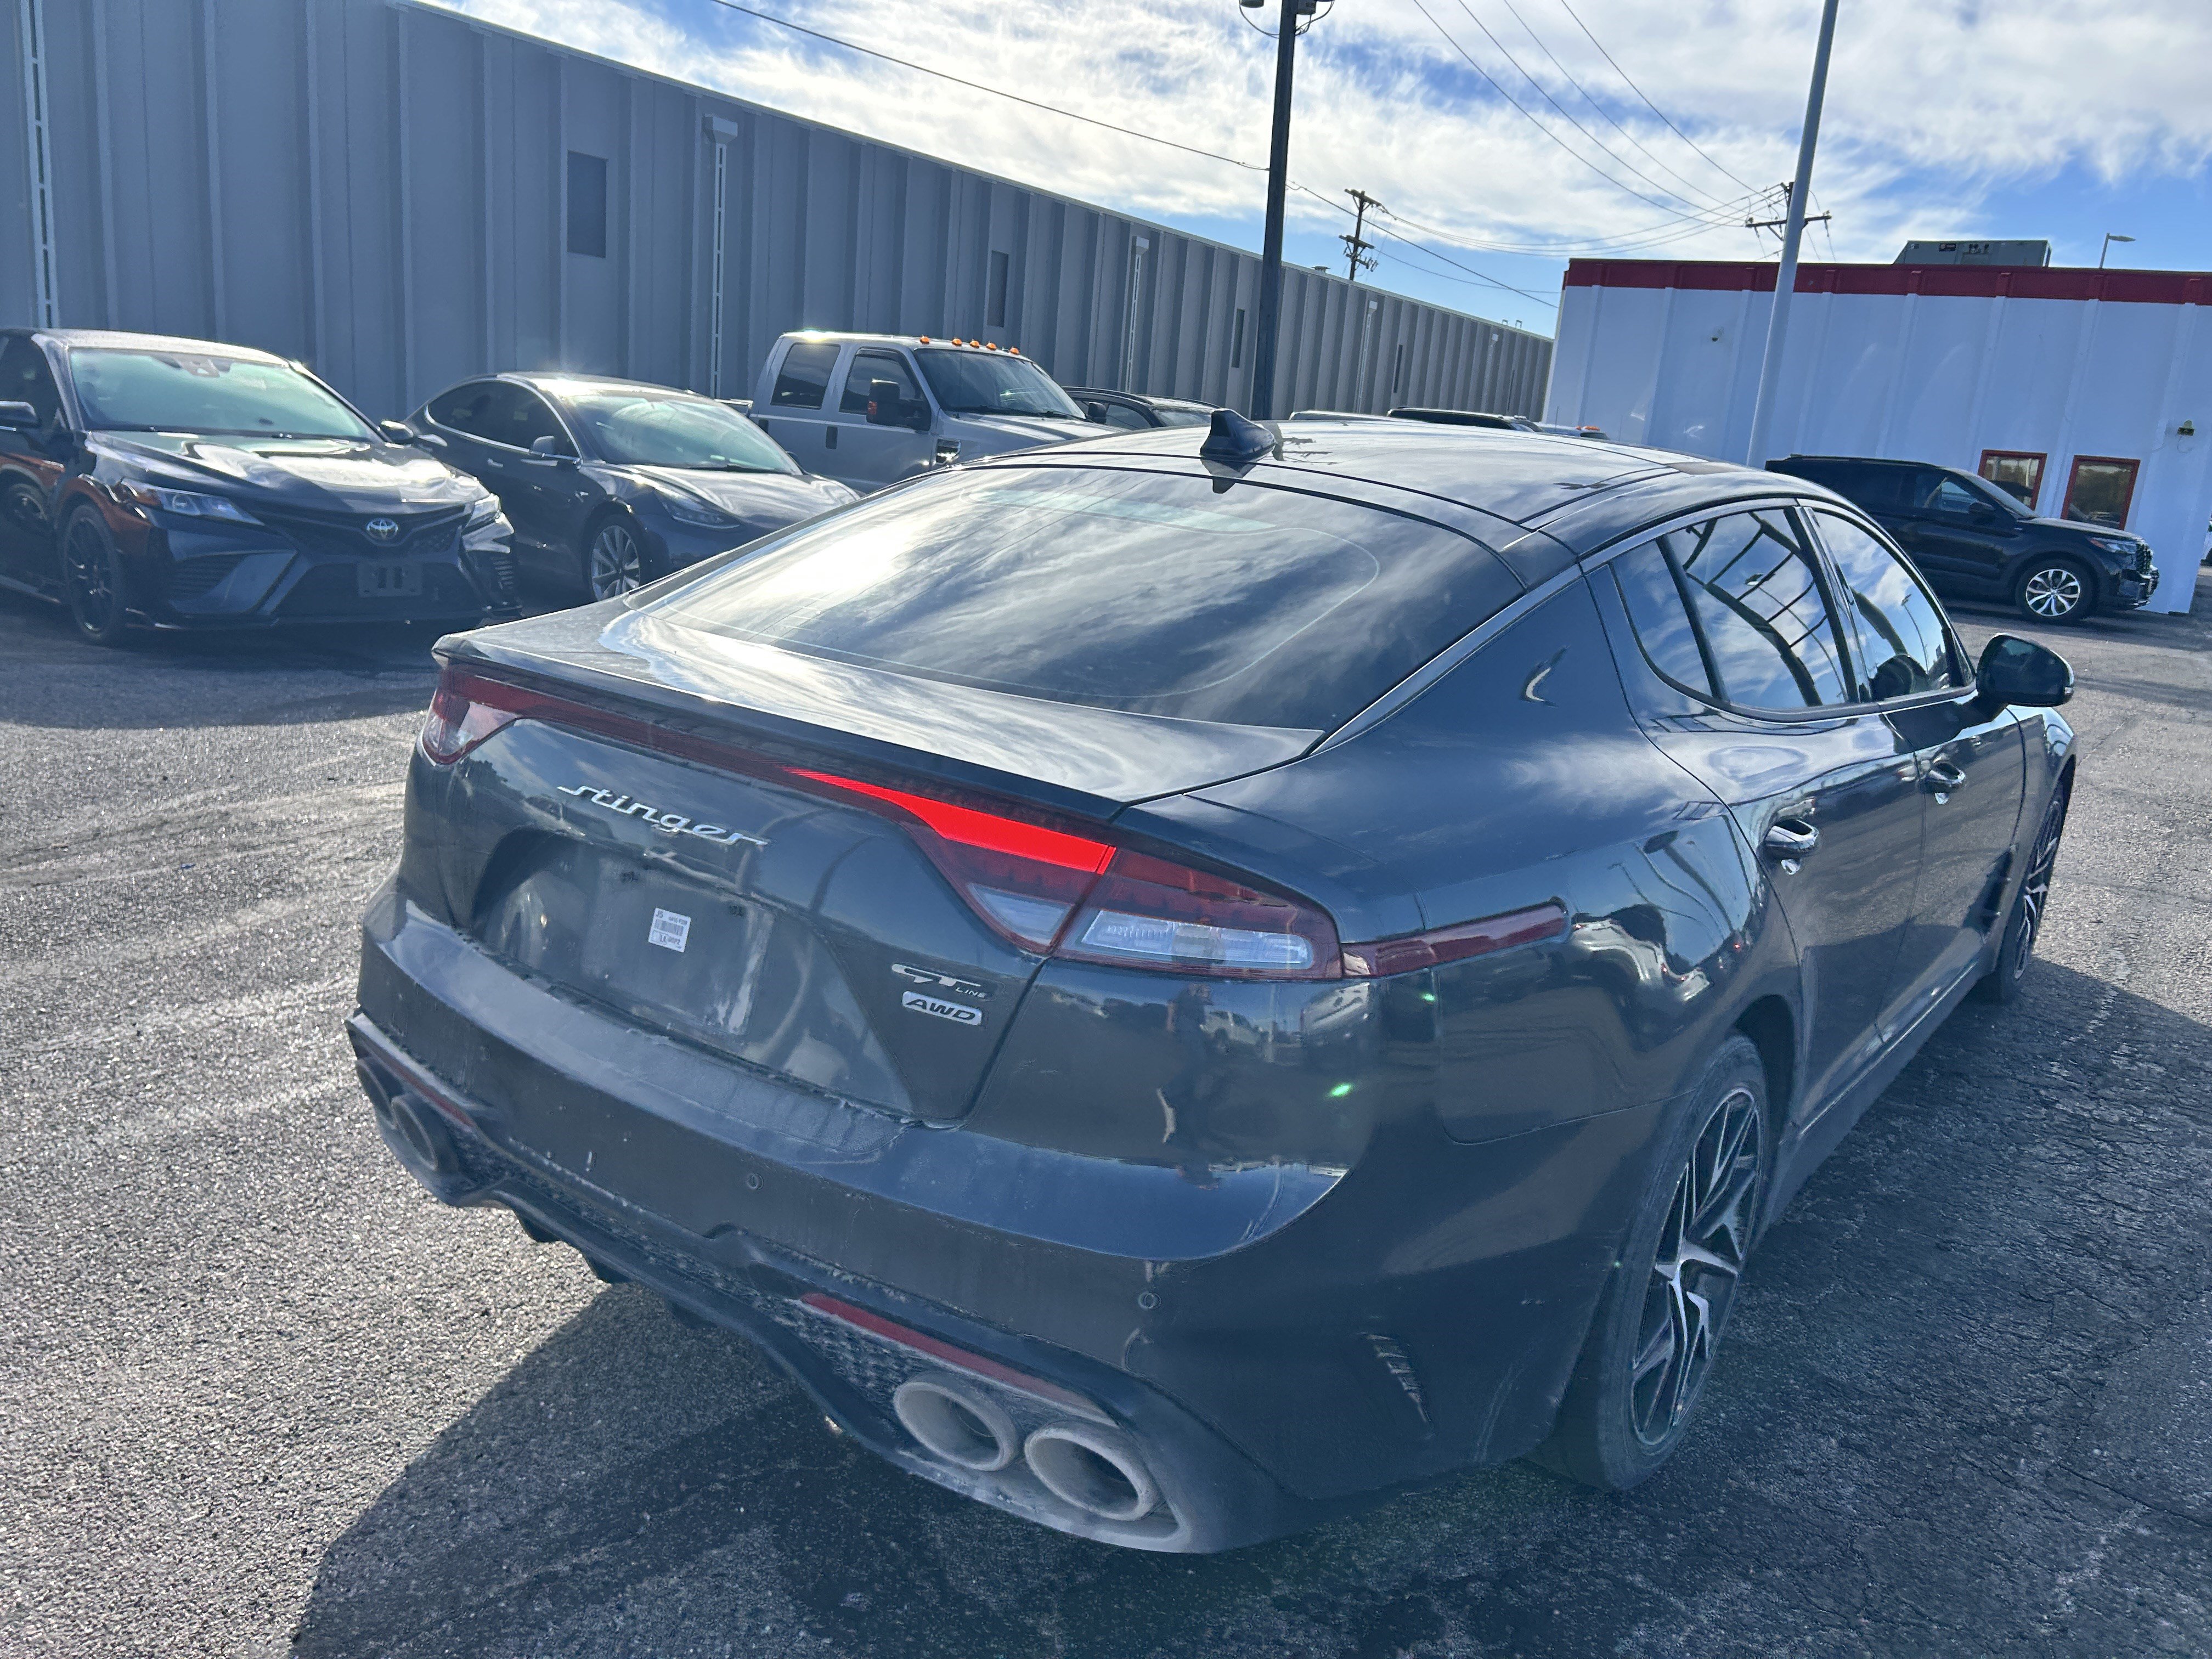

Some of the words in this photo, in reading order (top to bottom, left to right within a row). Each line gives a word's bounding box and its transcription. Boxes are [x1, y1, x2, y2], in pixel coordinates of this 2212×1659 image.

[891, 963, 981, 987] GT
[956, 987, 986, 998] LINE
[905, 998, 975, 1021] AWD
